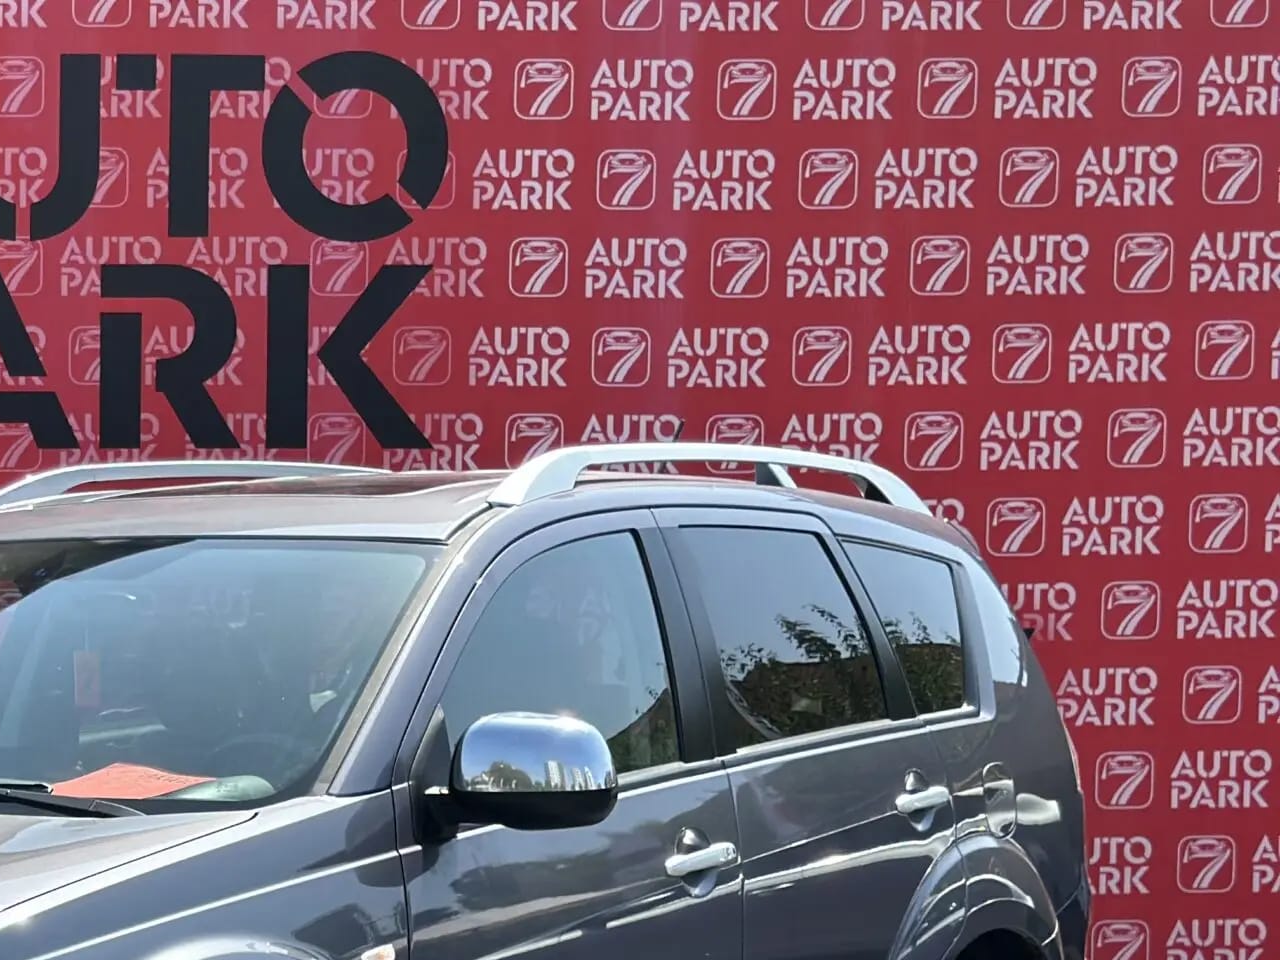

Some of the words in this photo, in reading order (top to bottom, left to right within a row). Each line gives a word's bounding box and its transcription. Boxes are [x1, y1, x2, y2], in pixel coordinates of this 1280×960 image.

[150, 0, 248, 28] PARK
[277, 0, 375, 29] PARK
[478, 0, 577, 31] PARK
[680, 1, 778, 31] PARK
[882, 0, 981, 30] PARK
[1084, 0, 1182, 30] PARK
[591, 59, 693, 89] AUTO
[793, 58, 896, 88] AUTO
[995, 57, 1097, 87] AUTO
[591, 91, 690, 121] PARK
[793, 90, 892, 120] PARK
[994, 88, 1093, 119] PARK
[473, 149, 574, 178] AUTO
[673, 149, 775, 179] AUTO
[875, 147, 977, 177] AUTO
[1076, 145, 1178, 175] AUTO
[473, 180, 571, 210] PARK
[673, 181, 772, 210] PARK
[875, 179, 974, 209] PARK
[1076, 176, 1174, 207] PARK
[61, 236, 161, 264] AUTO
[187, 237, 287, 264] AUTO
[386, 237, 487, 265] AUTO
[585, 238, 687, 267] AUTO
[786, 236, 888, 266] AUTO
[987, 234, 1089, 264] AUTO
[585, 269, 684, 298] PARK
[787, 267, 885, 297] PARK
[987, 265, 1086, 295] PARK
[469, 327, 569, 355] AUTO
[667, 327, 769, 356] AUTO
[868, 324, 970, 354] AUTO
[1069, 321, 1170, 352] AUTO
[469, 357, 566, 386] PARK
[668, 358, 766, 387] PARK
[868, 355, 967, 386] PARK
[1069, 352, 1167, 383] PARK
[581, 414, 680, 443] AUTO
[782, 412, 882, 441] AUTO
[980, 409, 1082, 439] AUTO
[1183, 406, 1280, 436] AUTO
[980, 440, 1079, 470] PARK
[1183, 437, 1280, 467] PARK
[1062, 495, 1164, 525] AUTO
[1062, 526, 1160, 556] PARK
[1177, 579, 1280, 608] AUTO
[1177, 609, 1280, 639] PARK
[1058, 667, 1157, 695] AUTO
[1058, 697, 1154, 725] PARK
[1171, 749, 1272, 778] AUTO
[1171, 780, 1268, 808] PARK
[1166, 918, 1267, 946] AUTO
